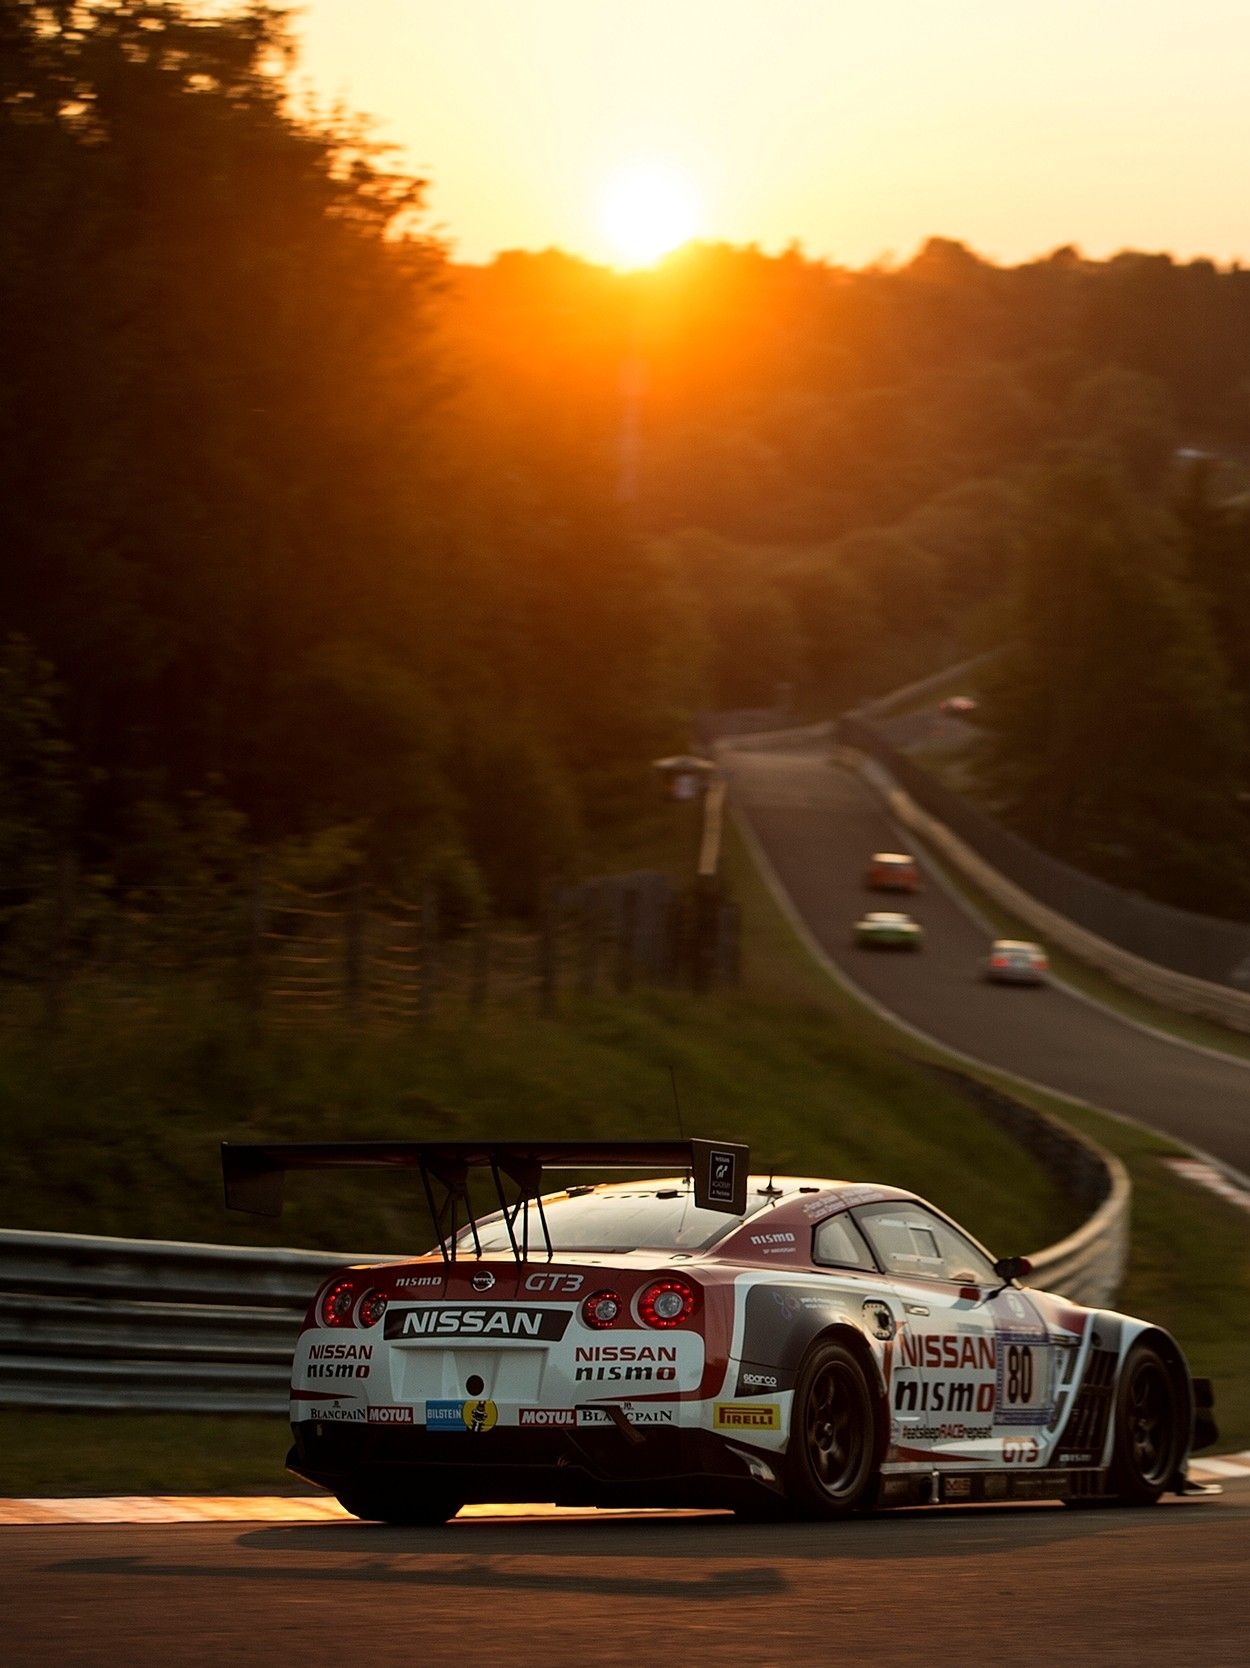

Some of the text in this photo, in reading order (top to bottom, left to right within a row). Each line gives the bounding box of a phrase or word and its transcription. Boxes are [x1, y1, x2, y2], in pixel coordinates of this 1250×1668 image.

[395, 1276, 442, 1287] nismo
[525, 1273, 584, 1292] GT3
[402, 1310, 543, 1335] NISSAN
[308, 1344, 373, 1360] NISSAN
[575, 1346, 677, 1362] NISSAN
[900, 1333, 996, 1370] NISSAN
[307, 1363, 370, 1379] nismo
[575, 1366, 676, 1381] nismo
[1007, 1344, 1032, 1404] 80
[743, 1373, 777, 1387] sparco
[895, 1380, 995, 1413] nismo
[310, 1407, 366, 1421] BLANCPAIN
[369, 1408, 412, 1422] MOTUL
[427, 1408, 462, 1420] BILSTEIN
[521, 1410, 574, 1425] MOTUL
[582, 1409, 673, 1422] BLACPAIN
[719, 1407, 773, 1425] PIRELLI
